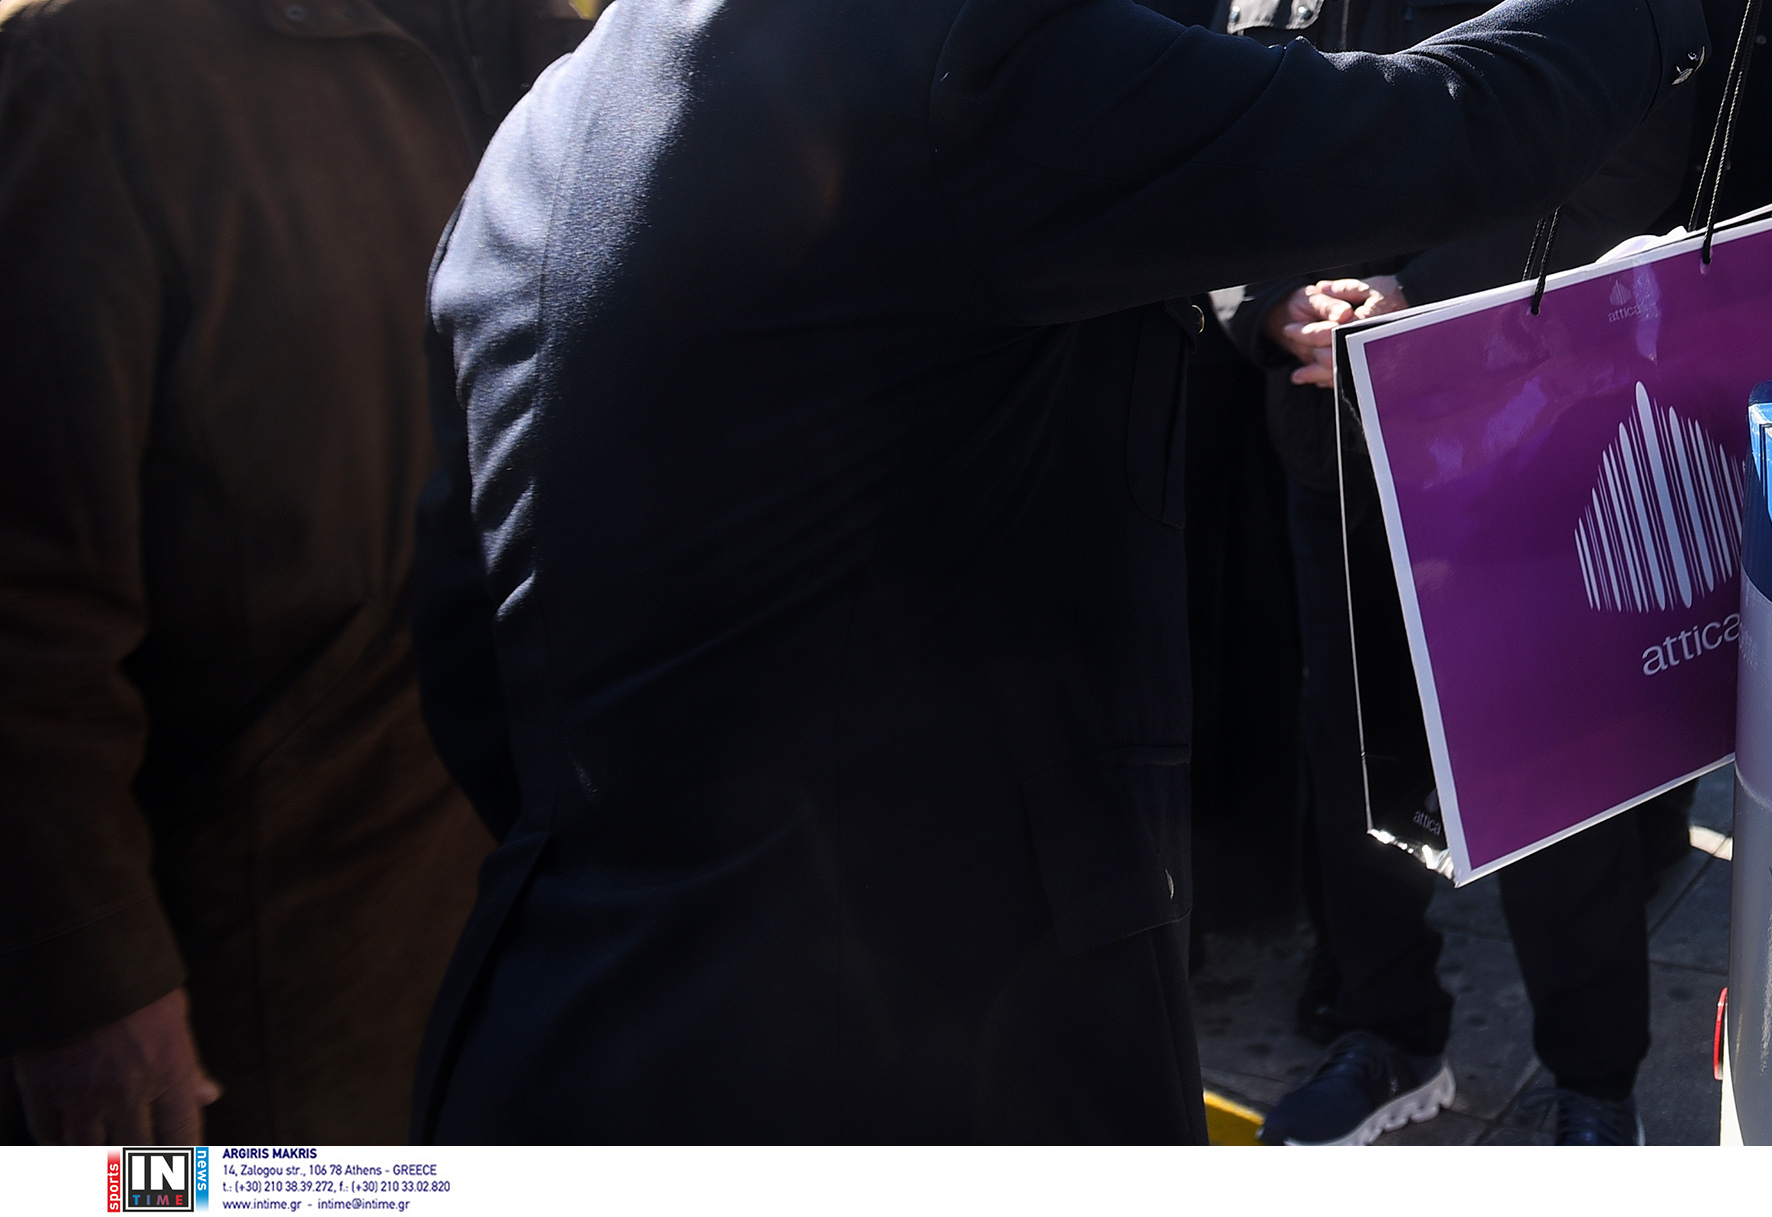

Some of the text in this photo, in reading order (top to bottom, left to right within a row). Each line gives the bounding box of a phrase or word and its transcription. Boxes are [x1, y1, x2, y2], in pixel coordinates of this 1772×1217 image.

[1608, 305, 1641, 323] attica
[1642, 613, 1740, 676] attica
[1413, 810, 1442, 835] attica
